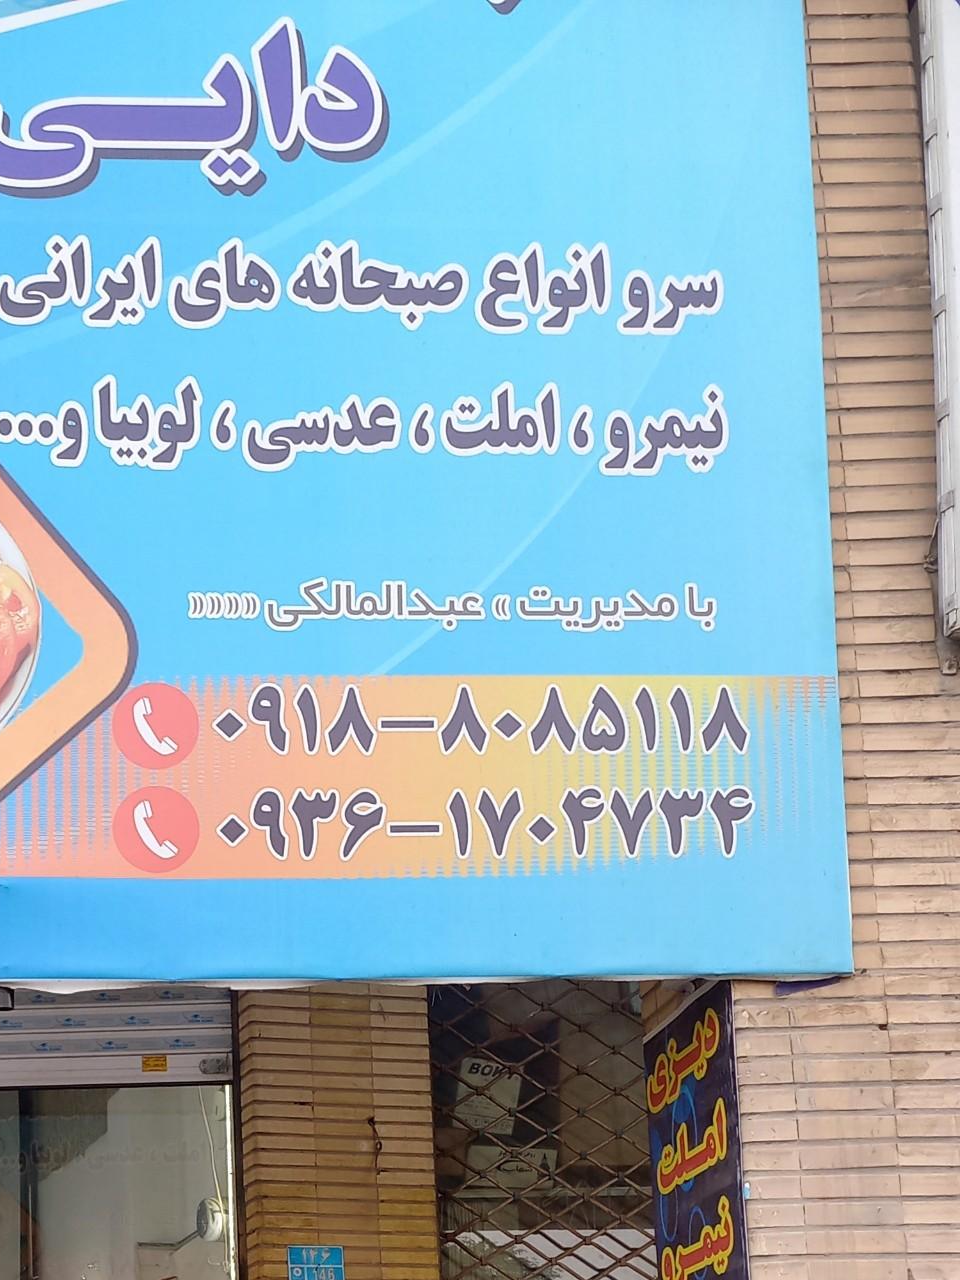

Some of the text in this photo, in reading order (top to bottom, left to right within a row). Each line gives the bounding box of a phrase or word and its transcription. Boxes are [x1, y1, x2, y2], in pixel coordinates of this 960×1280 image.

[169, 237, 280, 329] های
[288, 239, 468, 330] صبحانه
[477, 241, 610, 333] انواع
[621, 266, 723, 332] سرو
[94, 374, 201, 470] لوبیا
[244, 395, 400, 470] عدسی
[441, 381, 558, 453] املت
[601, 384, 728, 474] نیمرو
[266, 577, 716, 632] با مدیریت عبدالمالکی
[648, 1007, 719, 1113] دیزی
[657, 1097, 727, 1195] املت
